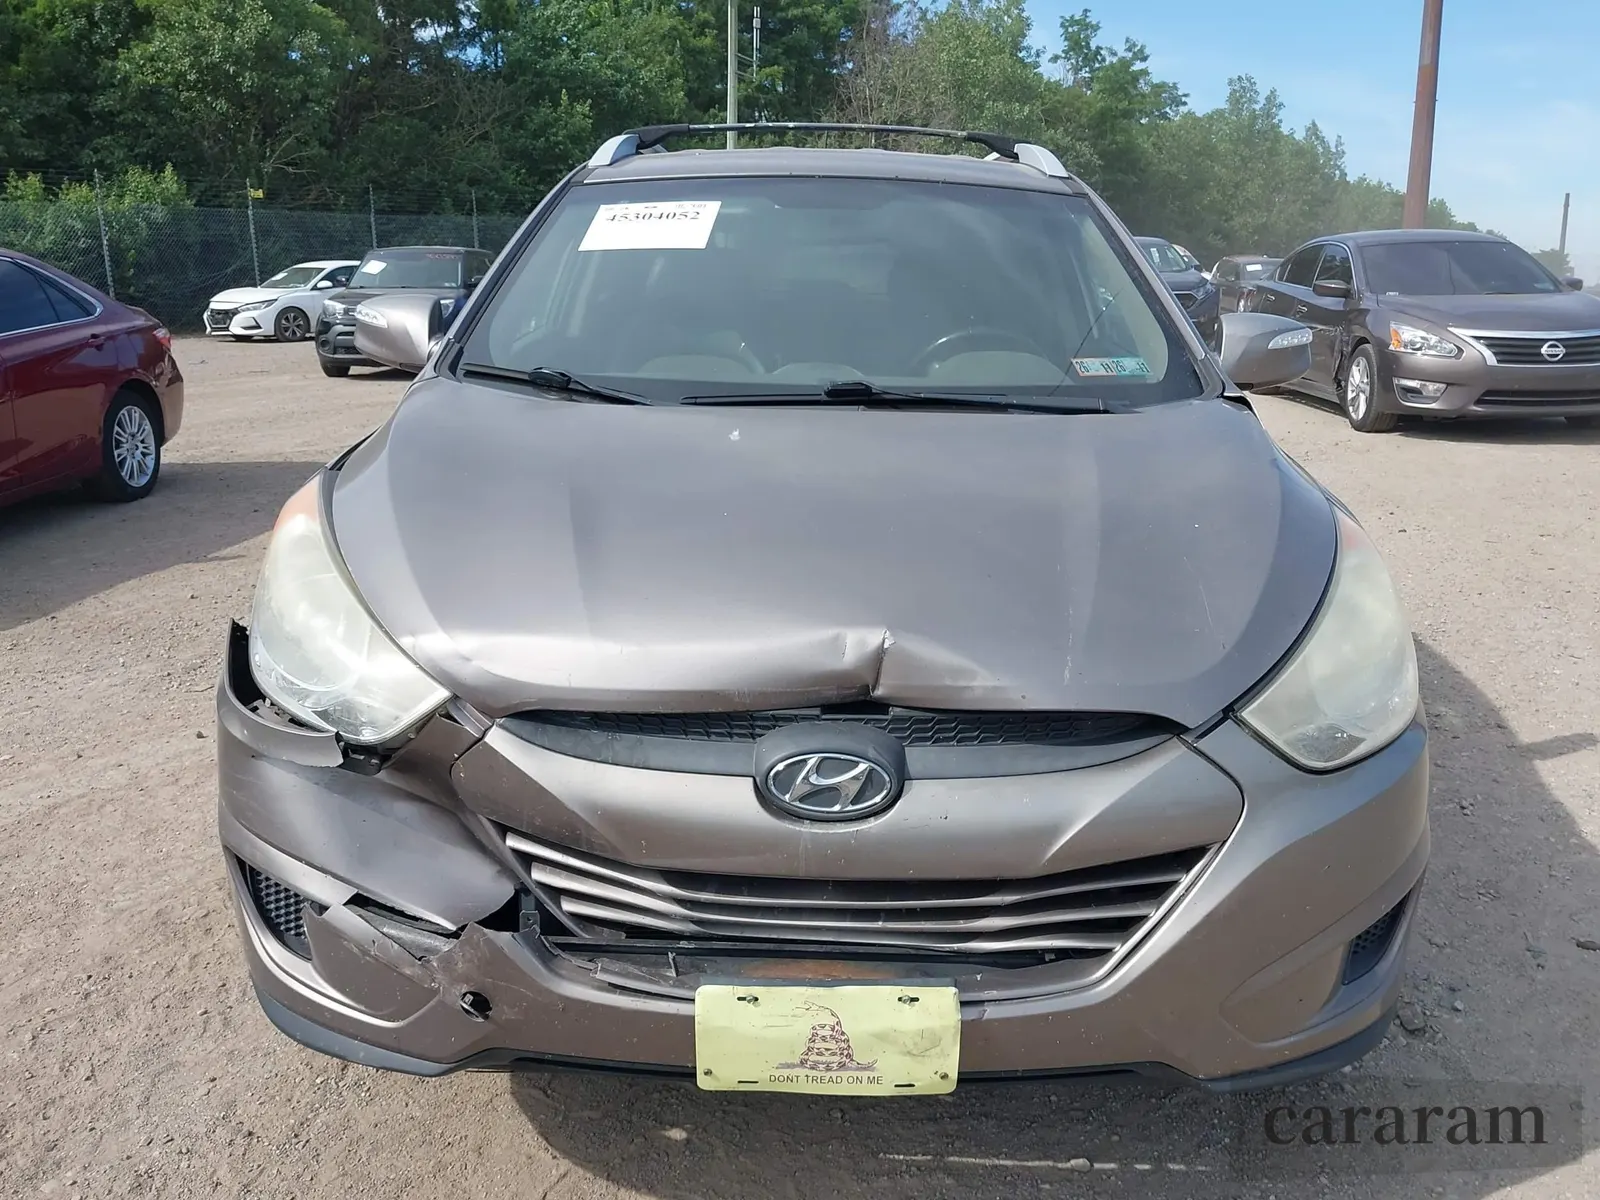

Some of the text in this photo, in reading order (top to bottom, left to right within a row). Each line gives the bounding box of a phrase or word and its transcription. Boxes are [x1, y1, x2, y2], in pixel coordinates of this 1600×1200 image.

[605, 211, 701, 222] 45304052
[805, 1074, 843, 1084] TREAD
[846, 1075, 863, 1084] ON
[866, 1076, 884, 1085] ME
